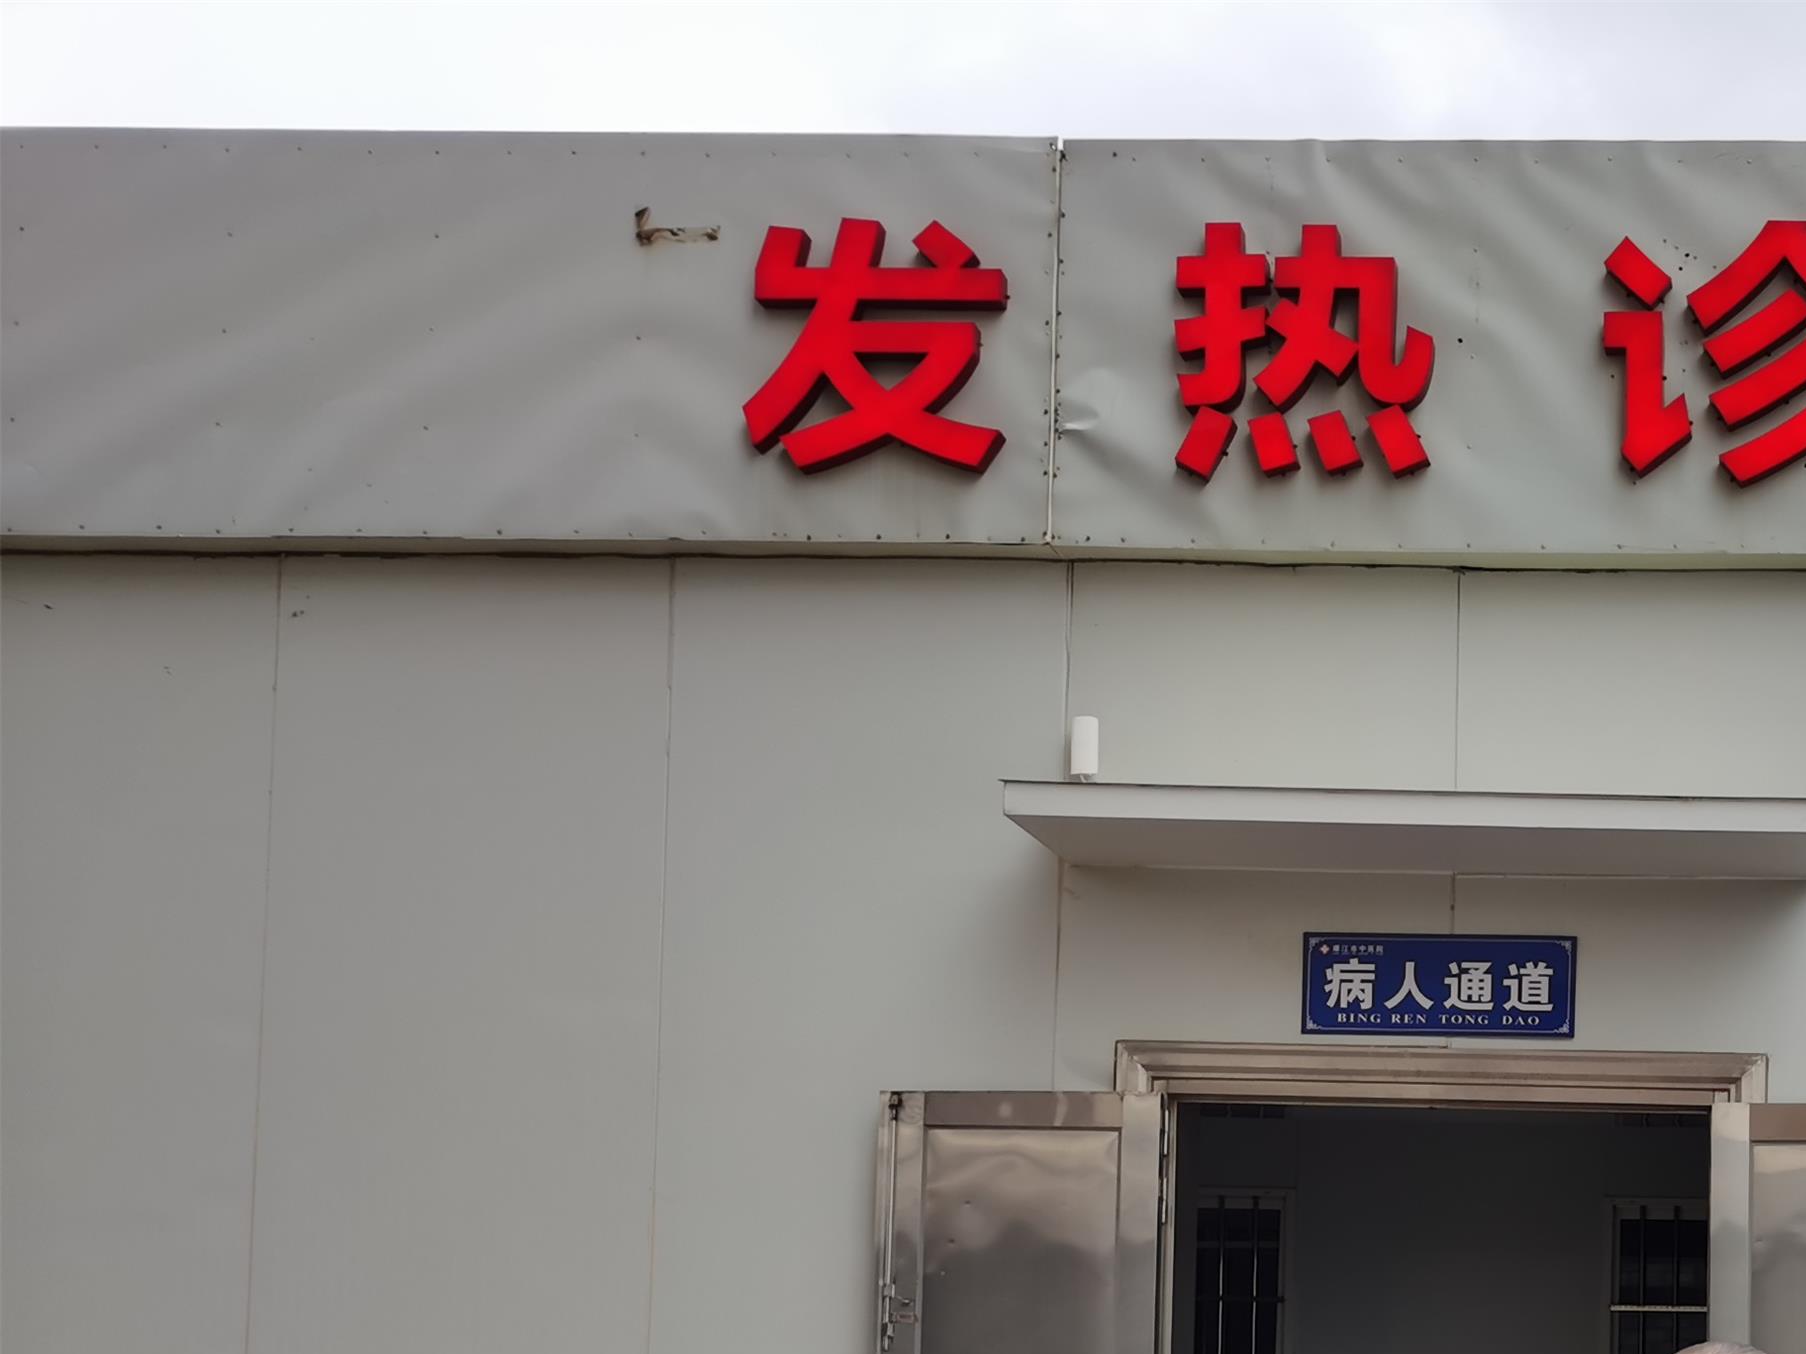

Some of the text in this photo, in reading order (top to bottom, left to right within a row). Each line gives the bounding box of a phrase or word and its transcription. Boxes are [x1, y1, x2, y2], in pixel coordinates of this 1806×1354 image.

[1323, 957, 1554, 1012] 病人通道
[1337, 1012, 1541, 1026] BING REN TONG DAO
